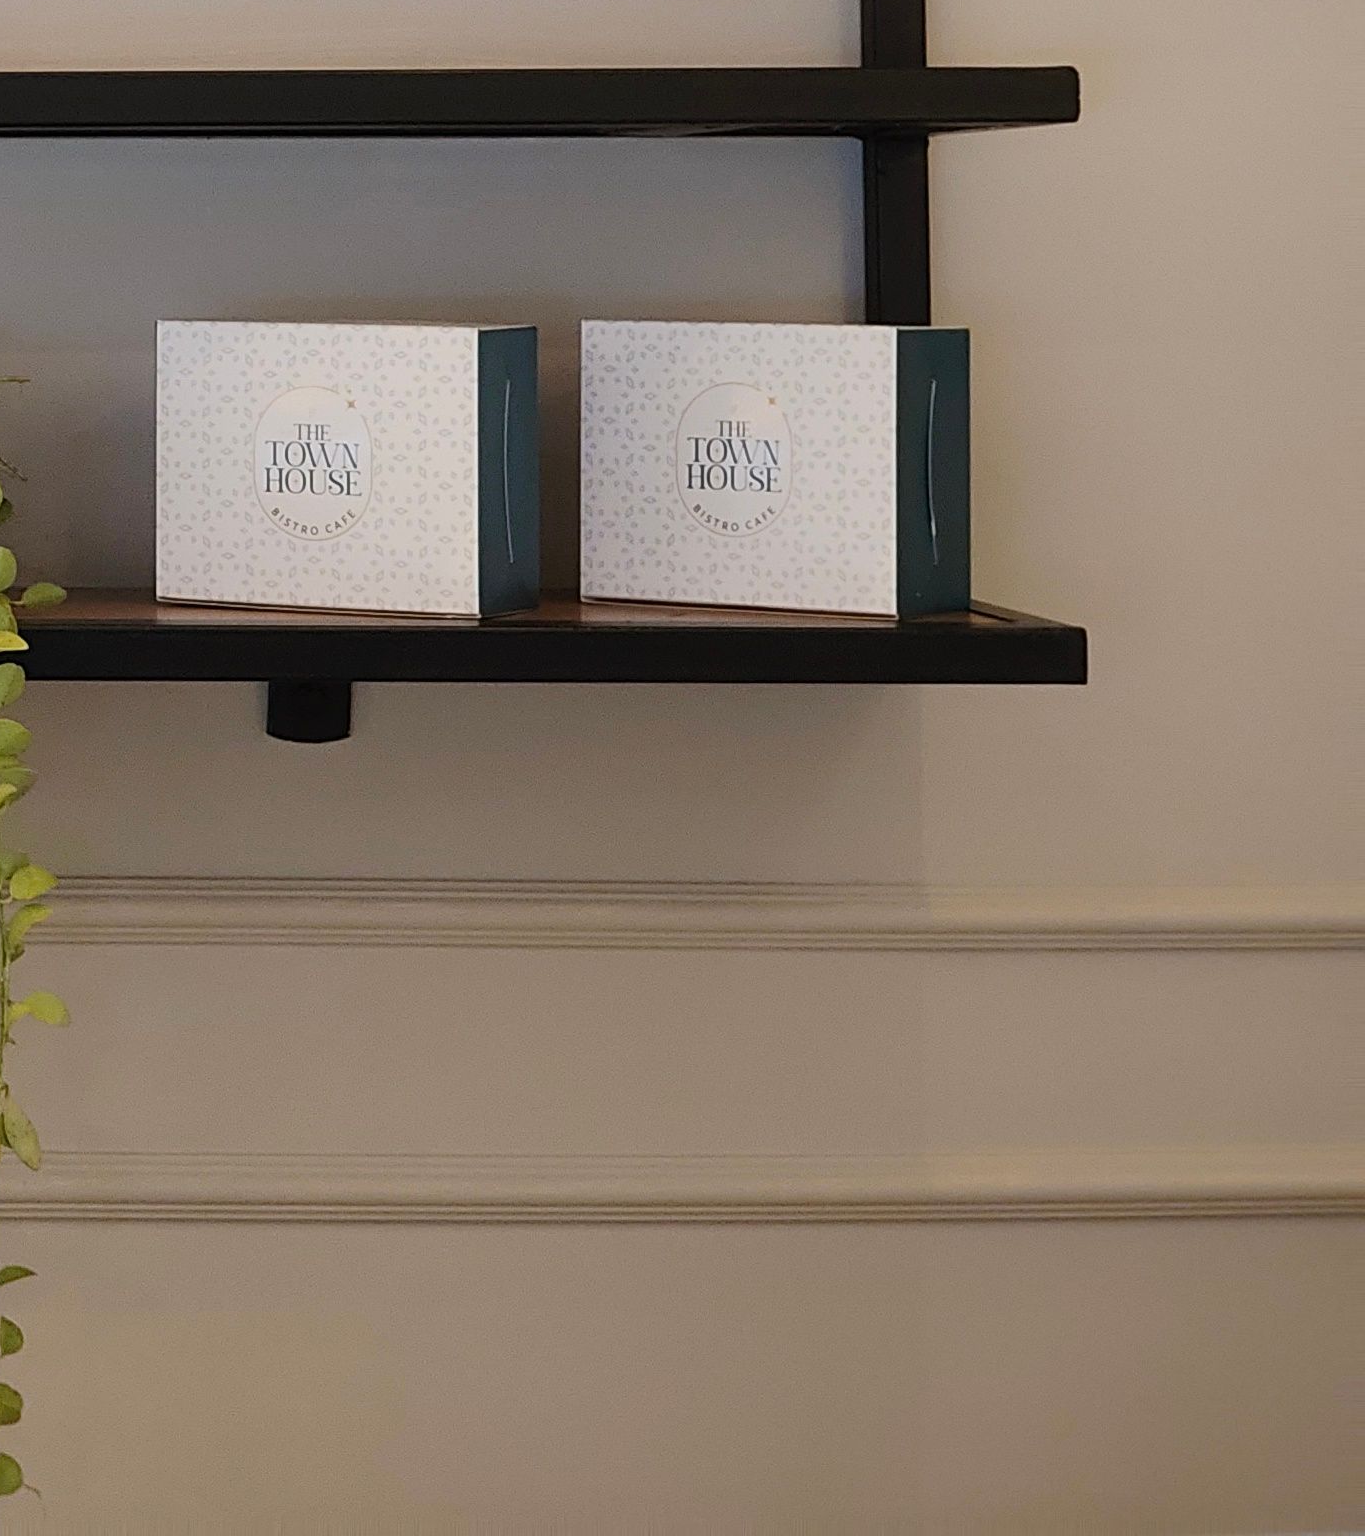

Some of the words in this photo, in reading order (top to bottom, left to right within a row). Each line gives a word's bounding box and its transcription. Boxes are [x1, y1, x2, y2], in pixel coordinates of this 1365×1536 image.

[293, 423, 331, 441] THE
[715, 420, 751, 438] THE
[264, 440, 360, 468] TOWN
[686, 437, 780, 464] TOWN
[264, 468, 362, 497] HOUSE
[686, 463, 782, 493] HOUSE
[270, 507, 319, 536] BISTRO
[324, 509, 358, 534] CAFE
[692, 504, 740, 532] BISTRO
[744, 505, 777, 530] CAFE
